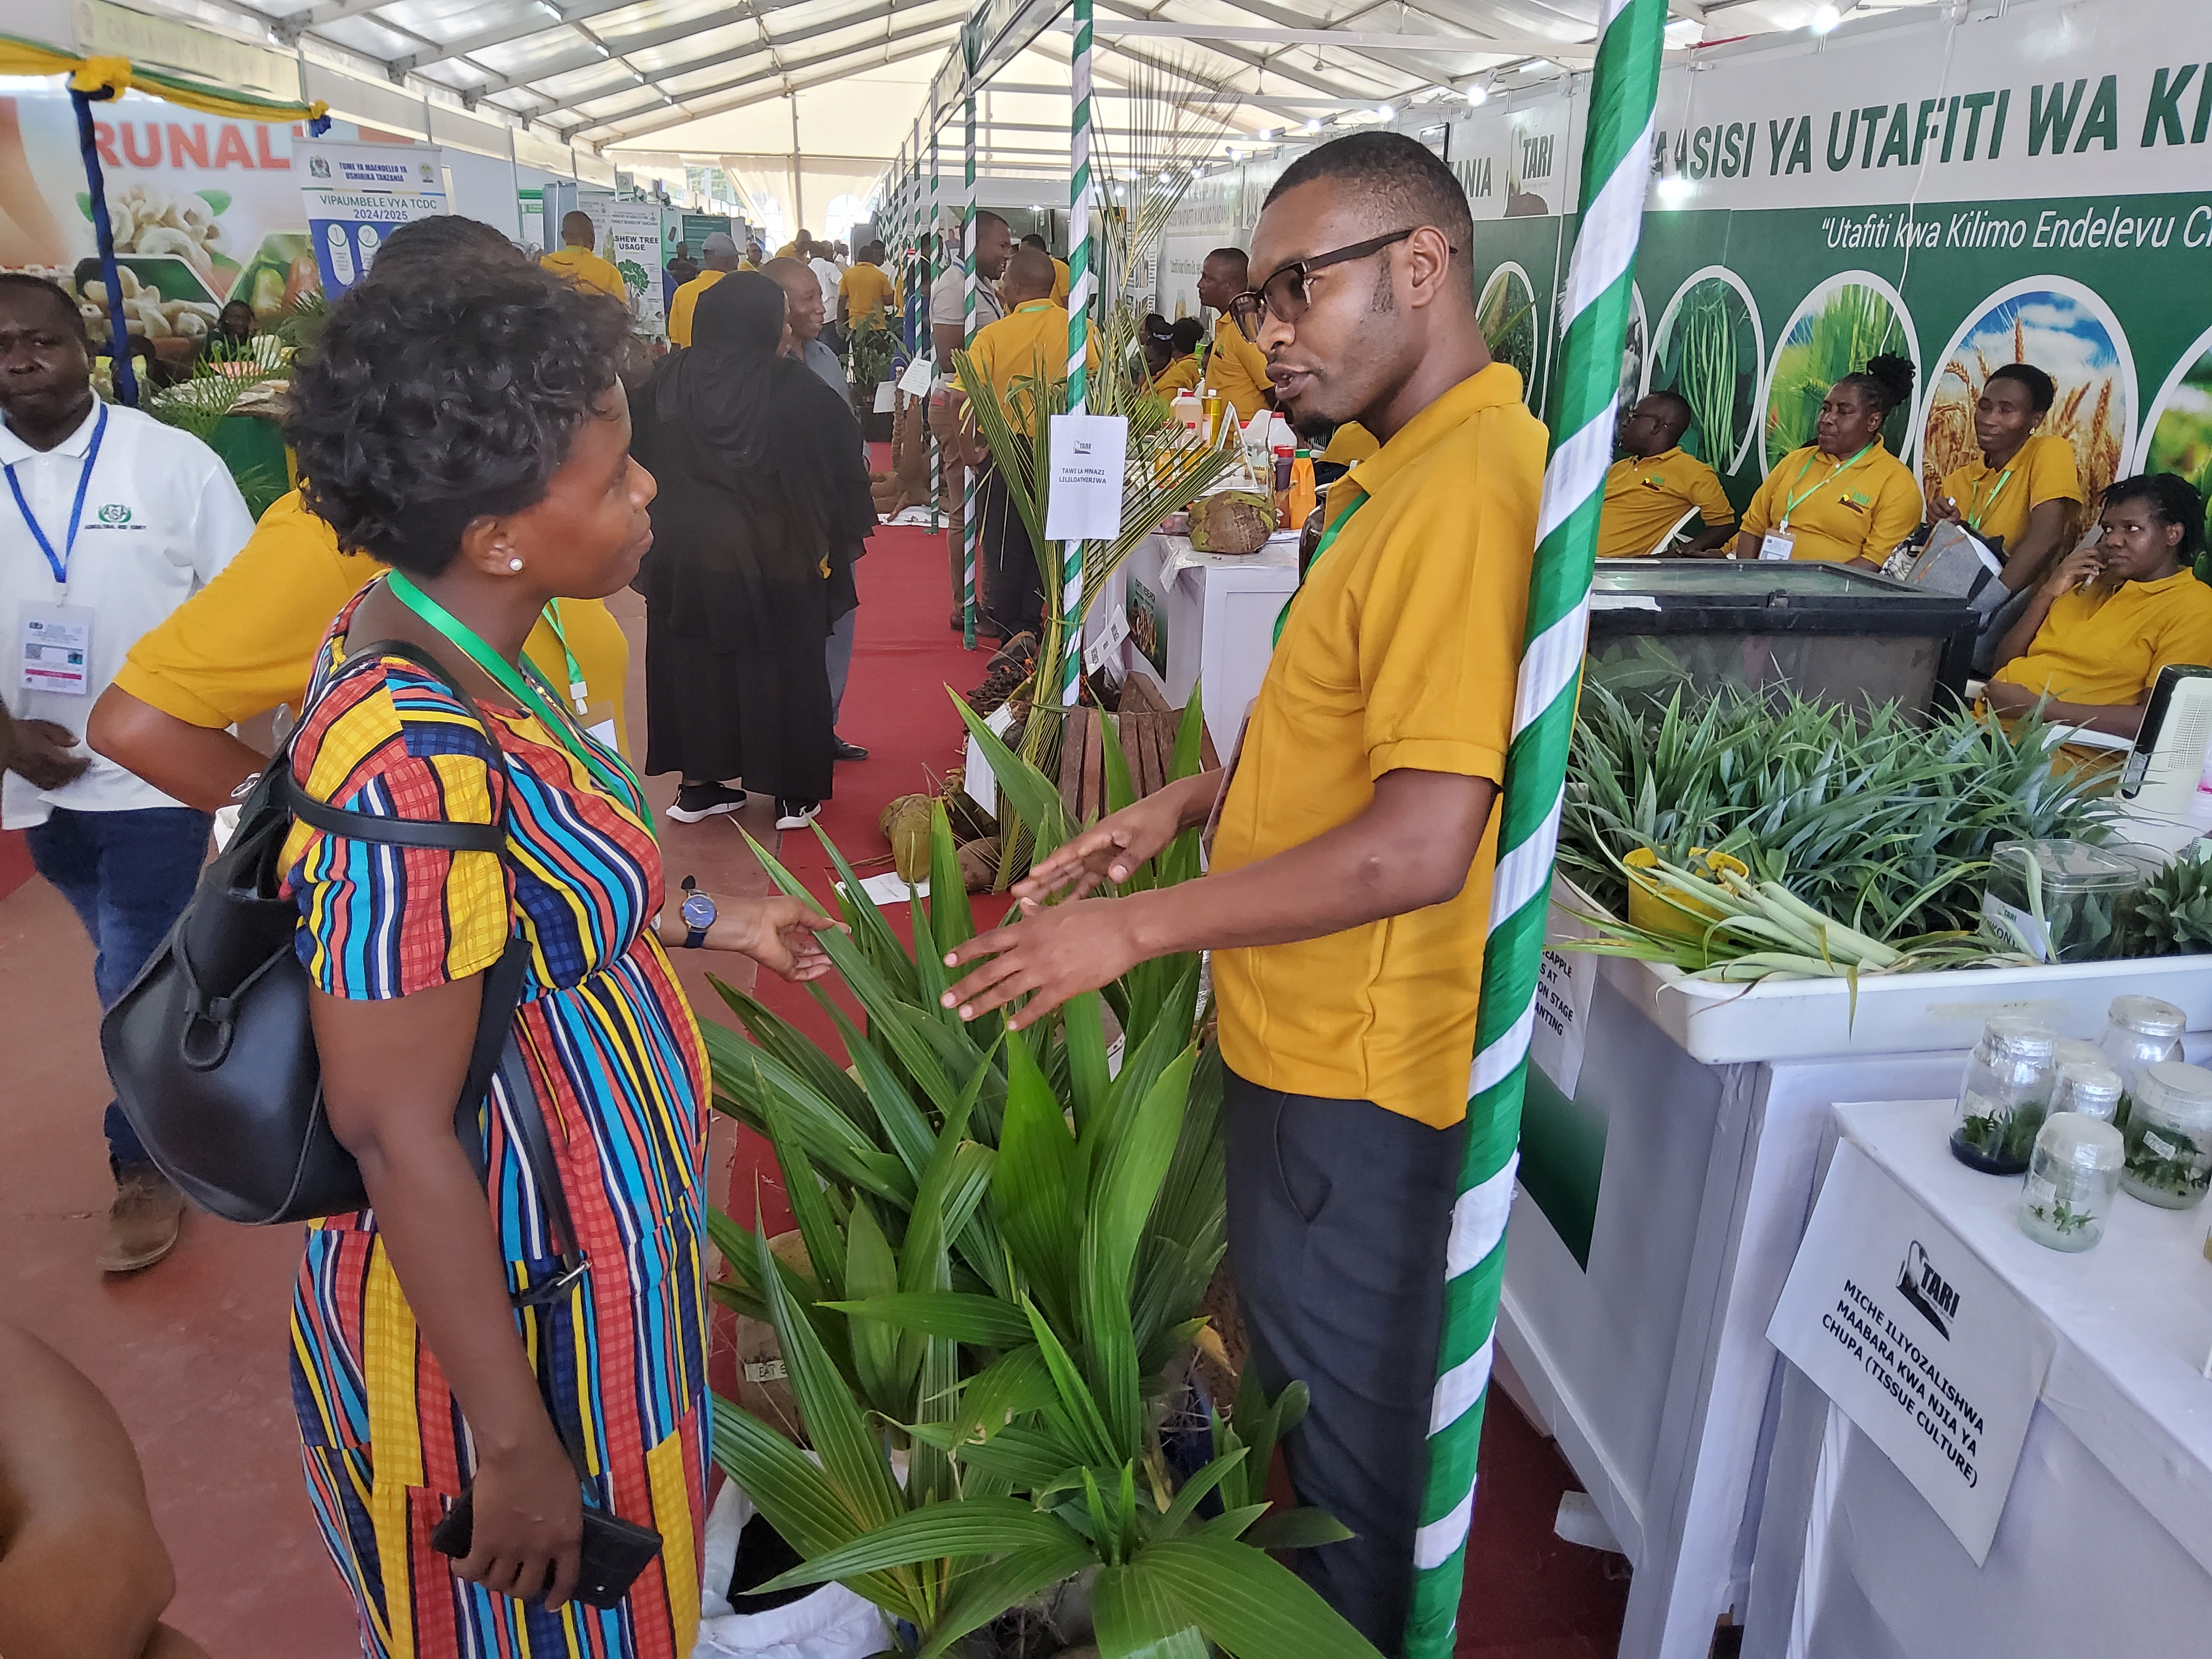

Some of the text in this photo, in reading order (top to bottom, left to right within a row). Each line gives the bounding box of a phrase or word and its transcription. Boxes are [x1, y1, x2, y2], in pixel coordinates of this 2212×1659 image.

[1769, 115, 1812, 176] YA
[1826, 89, 2011, 172] UTAFITI
[2028, 74, 2117, 156] WA
[1522, 134, 1555, 180] TARI
[339, 162, 408, 173] TUME YA MAENDELEO YA
[345, 171, 405, 182] USHIRIKA TANZANIA
[319, 195, 437, 210] VIPAUMBELE VYA TCDC
[353, 208, 409, 221] 2024/2025
[332, 228, 339, 242] 1
[1893, 212, 1941, 248] kwa
[1945, 210, 2027, 248] Kilimo
[2031, 206, 2175, 248] Endelevu
[363, 229, 374, 243] 2
[614, 235, 660, 244] SHEW TREE
[618, 243, 646, 251] USAGE
[1059, 476, 1107, 484] LILILOATHIRIWA
[1084, 468, 1105, 476] MNAZI
[2004, 909, 2017, 922] TARI
[1542, 950, 1572, 979] EAPPLE
[1546, 968, 1558, 985] AT
[1537, 981, 1574, 1022] ON STAGE
[1535, 1002, 1564, 1036] ANTING
[1920, 1261, 1960, 1319] TARI
[1843, 1279, 1885, 1327] MICHE
[1885, 1319, 1984, 1436] ILIYOZALISHWA
[1836, 1299, 1977, 1458] MAABARA KWA NJIA YA
[1822, 1313, 1978, 1489] CHUPA (TISSUE CULTURE)
